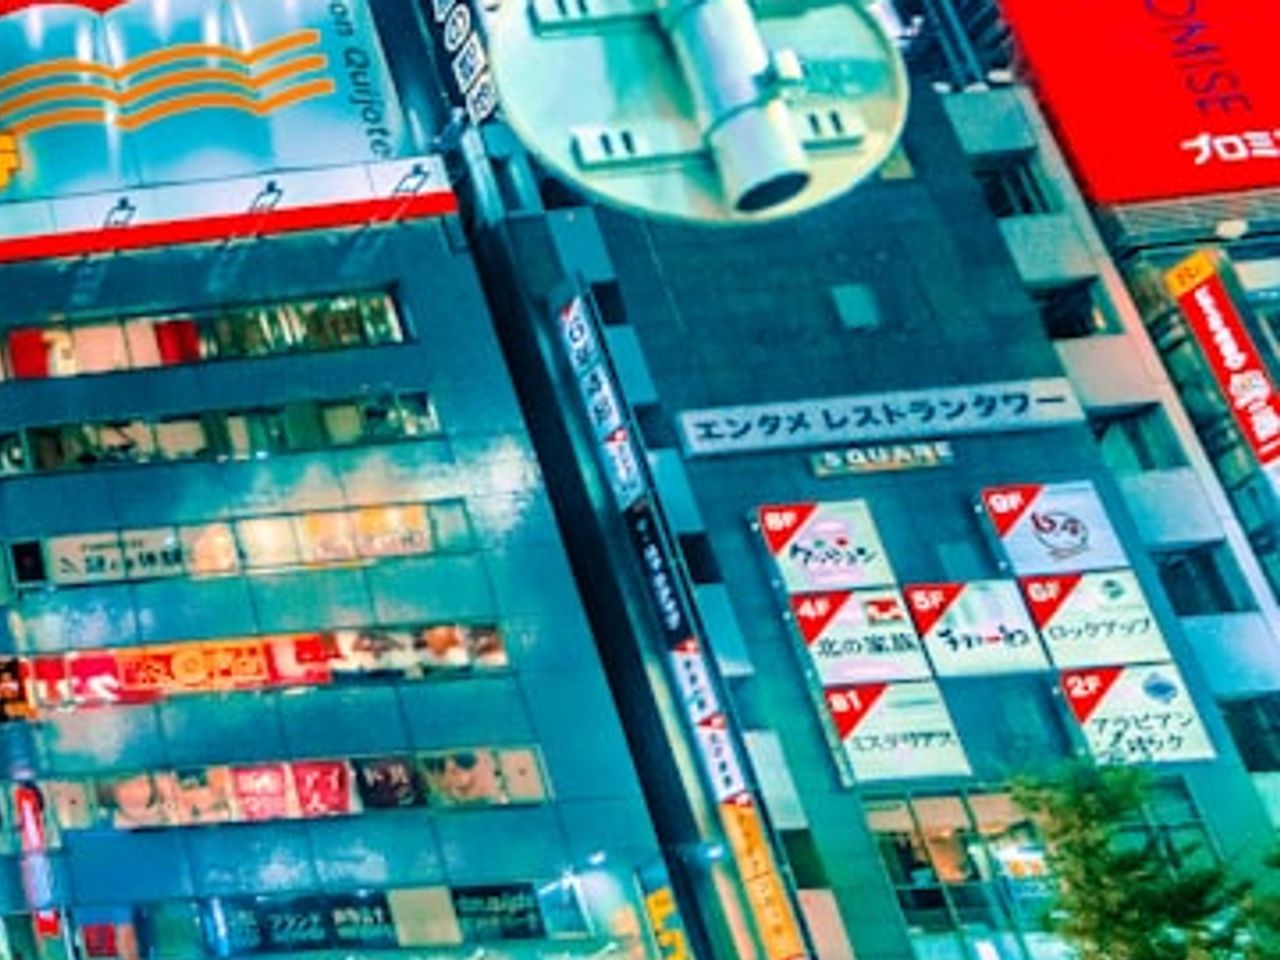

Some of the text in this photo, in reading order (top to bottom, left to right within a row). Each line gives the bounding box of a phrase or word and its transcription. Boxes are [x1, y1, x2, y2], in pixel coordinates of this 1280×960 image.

[694, 391, 1069, 441] エンタメ レストランタワー
[796, 597, 832, 621] 4F
[819, 632, 918, 657] 北の家族
[1067, 674, 1104, 699] 2F
